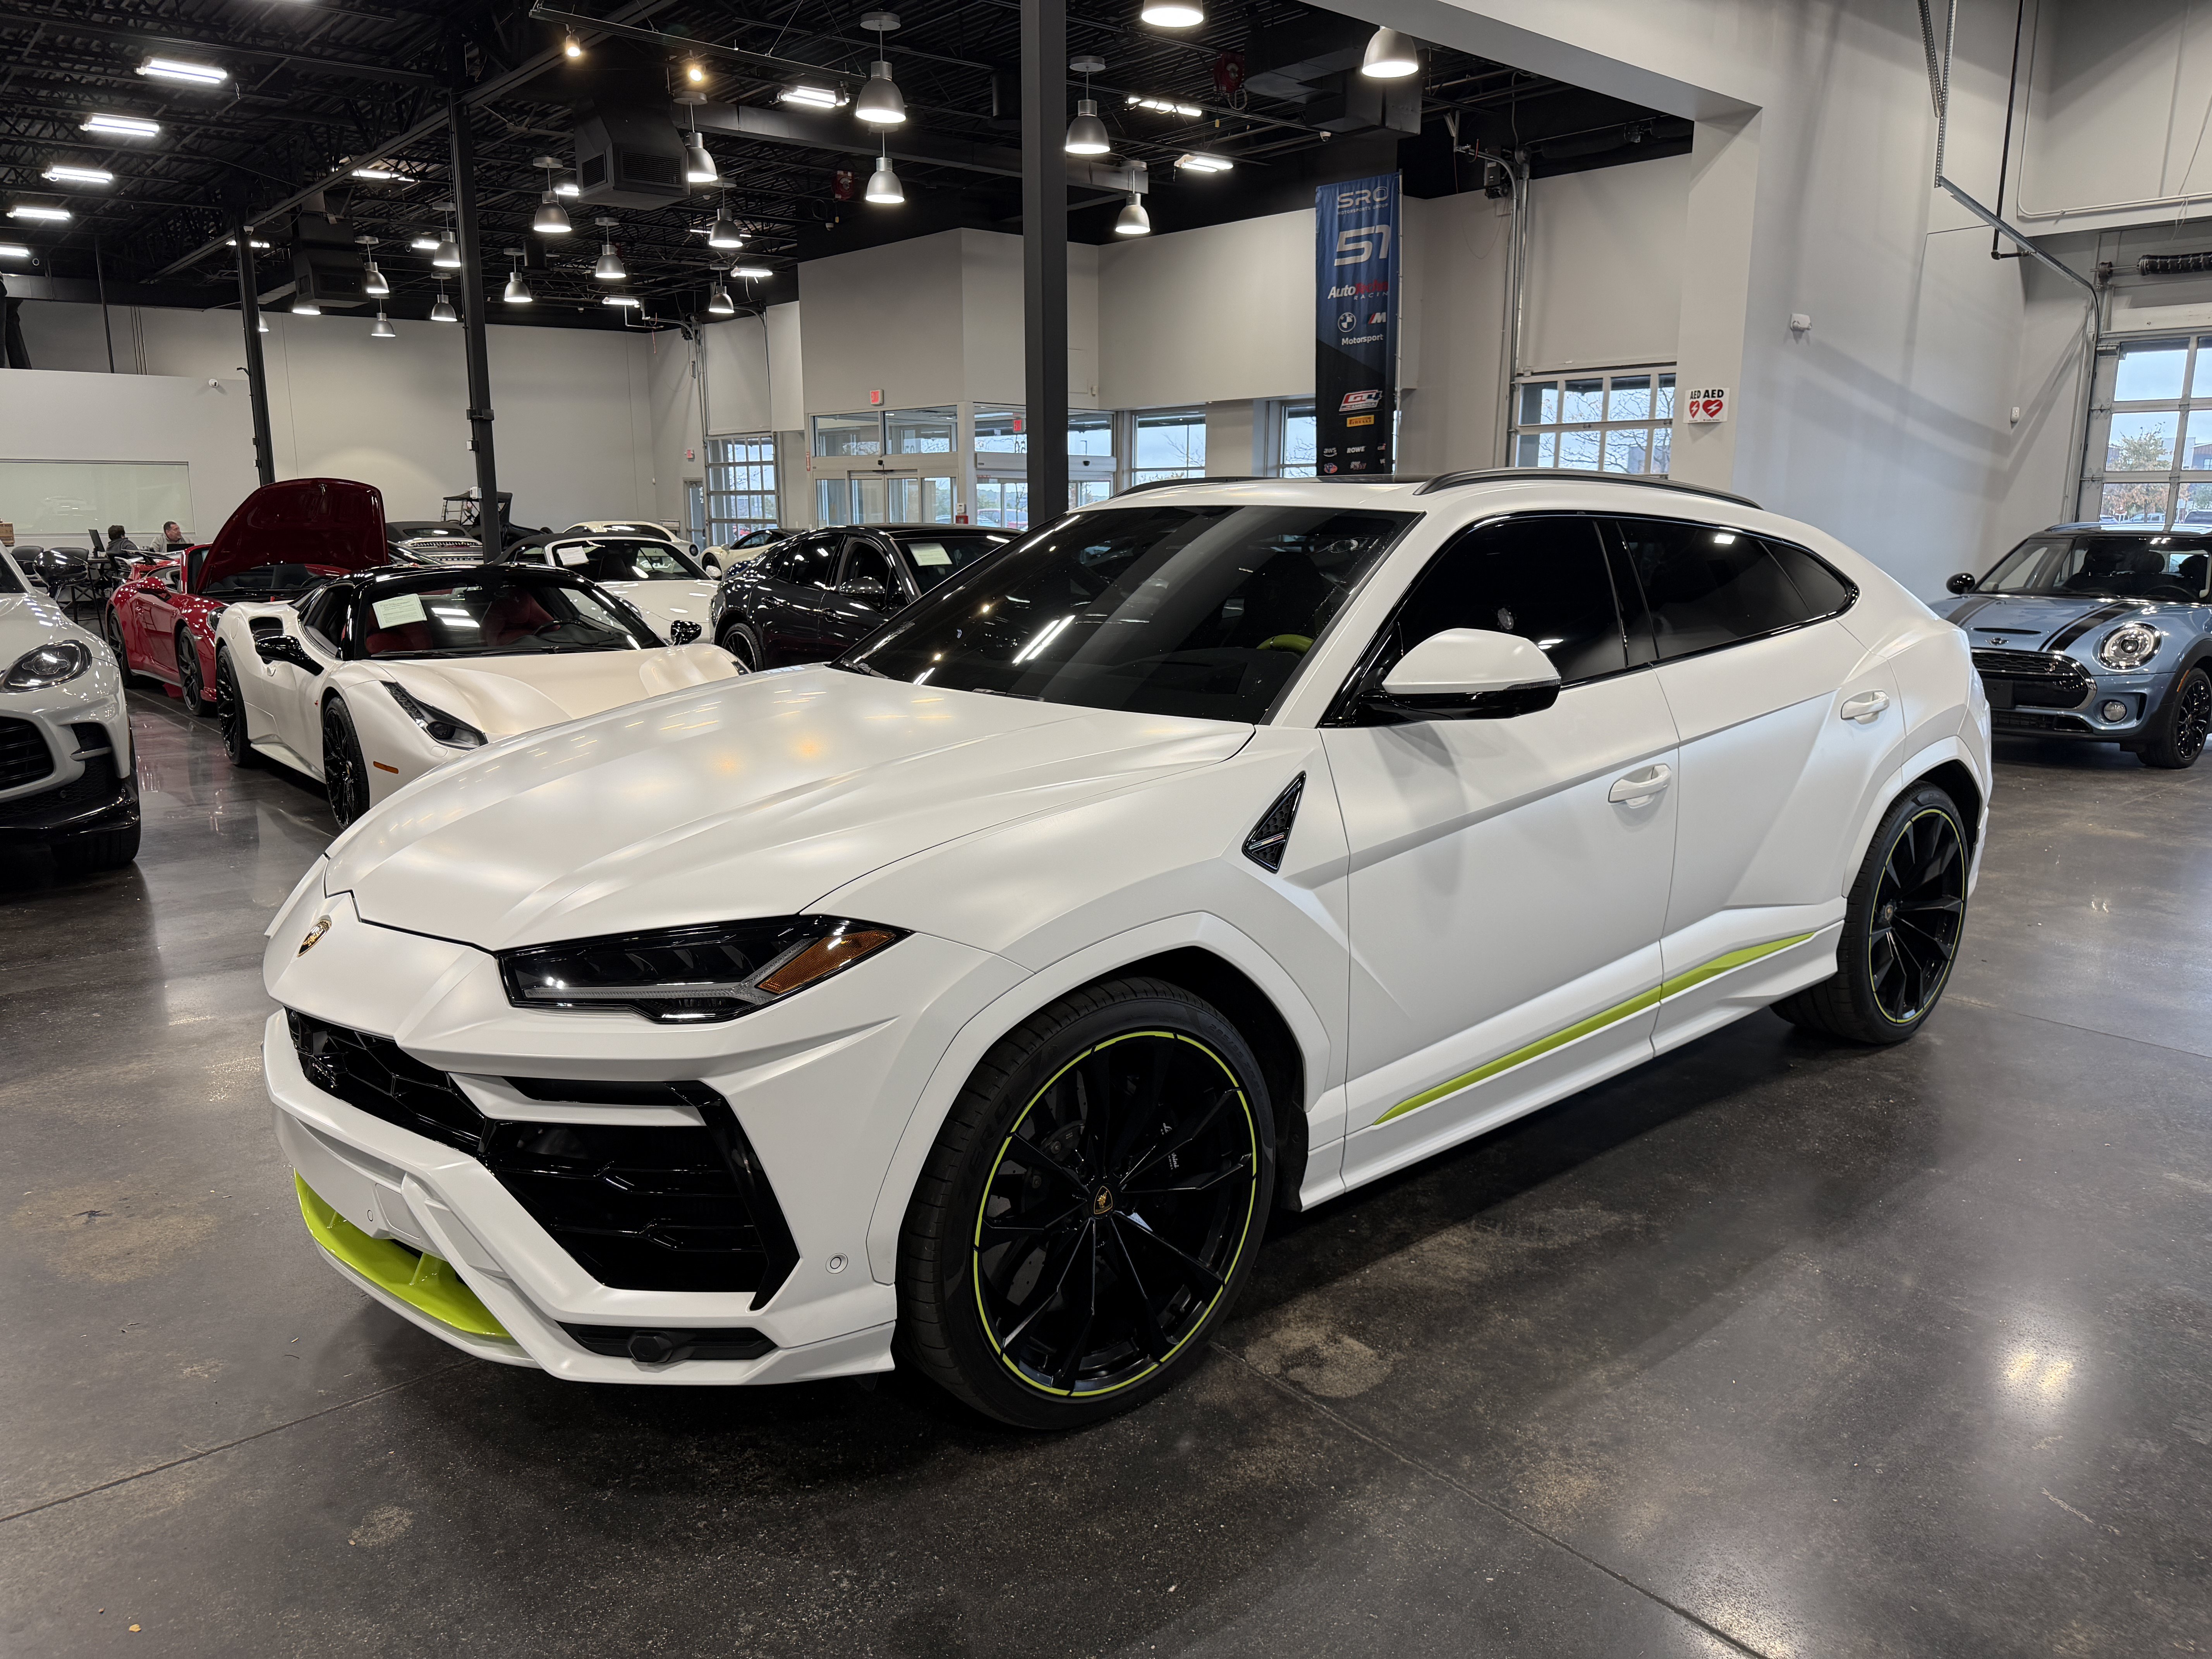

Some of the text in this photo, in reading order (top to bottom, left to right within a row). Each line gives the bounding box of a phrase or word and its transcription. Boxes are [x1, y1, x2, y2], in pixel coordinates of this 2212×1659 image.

[1338, 186, 1389, 208] SRO
[1341, 334, 1384, 345] Motorsport
[1690, 390, 1701, 400] AED
[1703, 389, 1724, 398] AED
